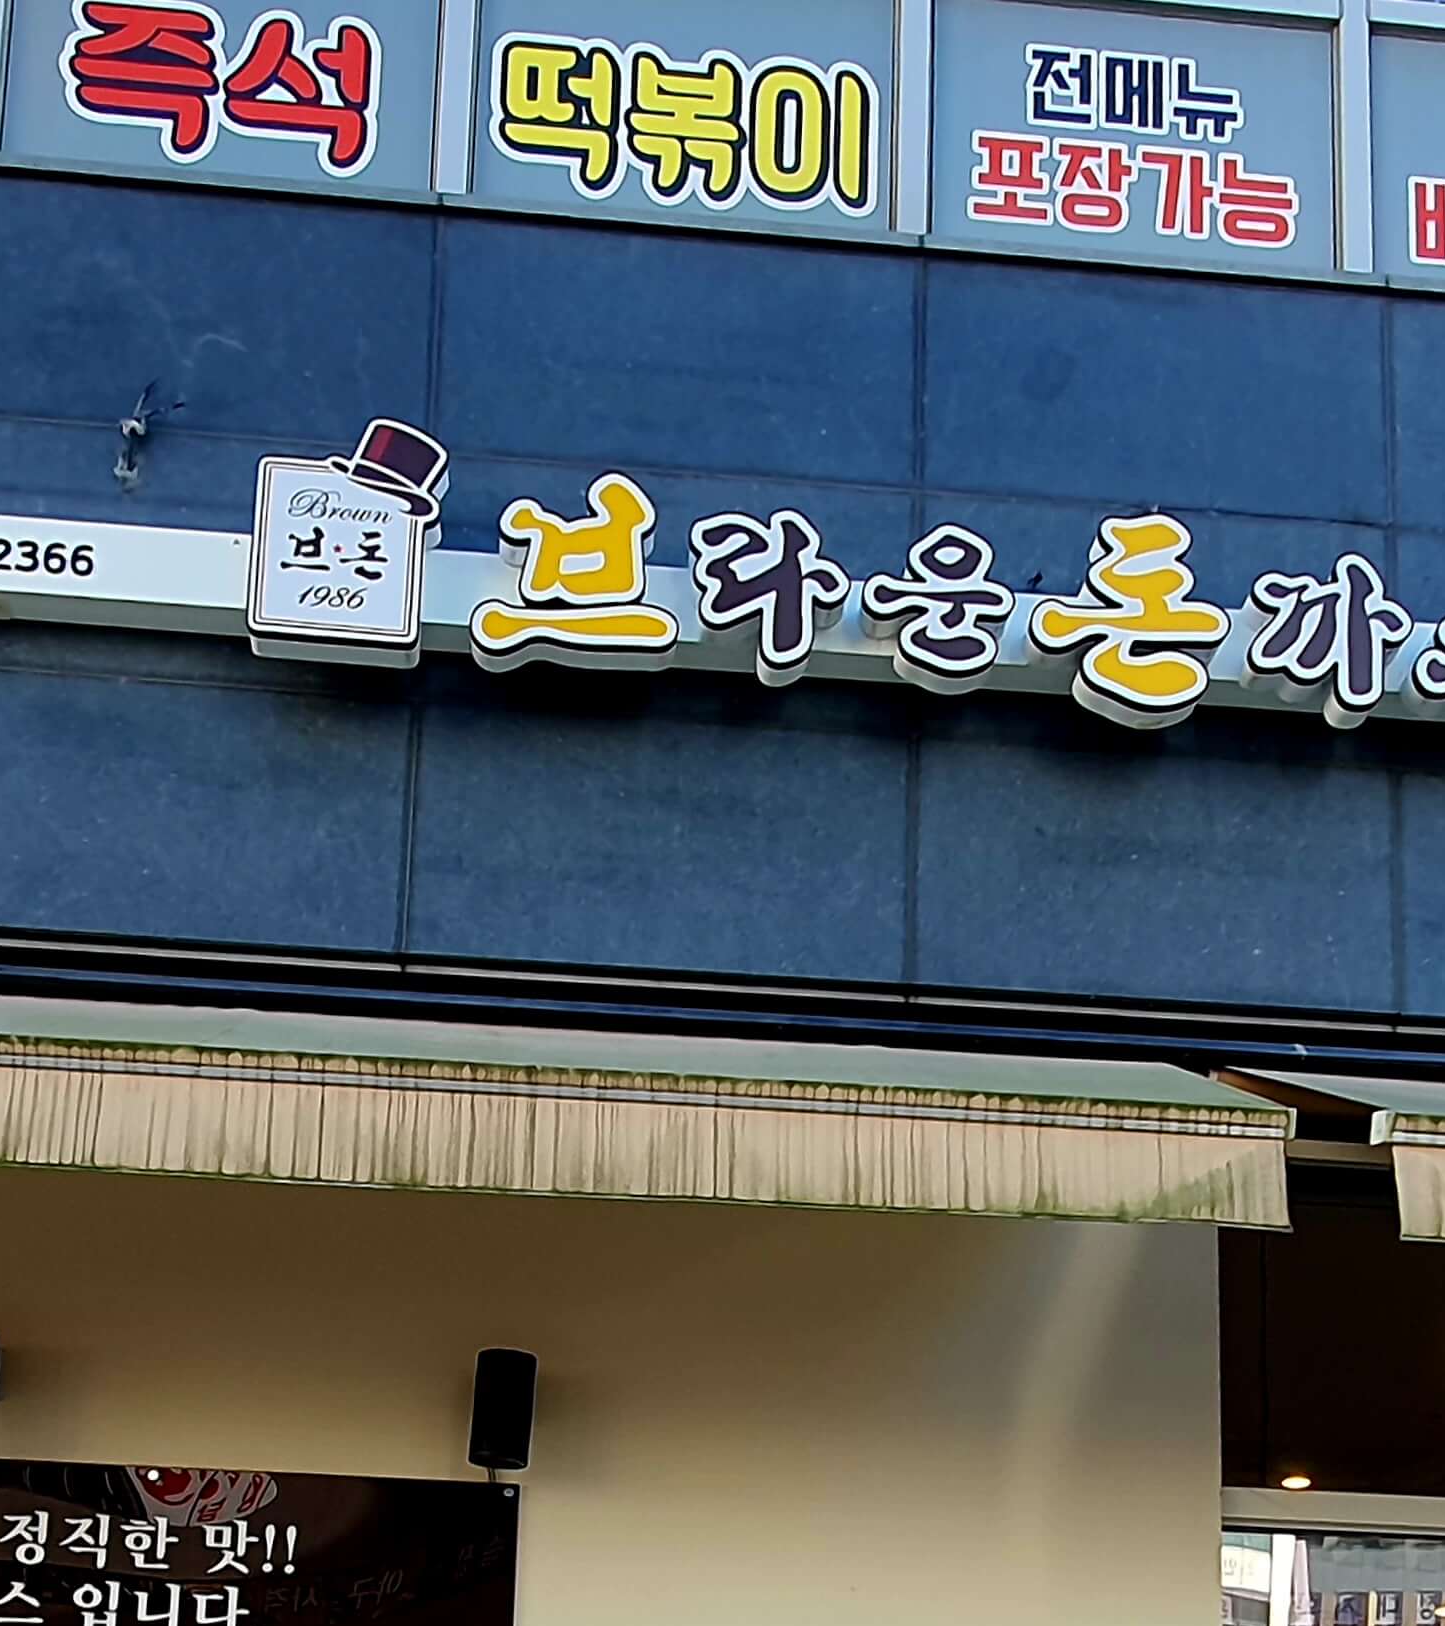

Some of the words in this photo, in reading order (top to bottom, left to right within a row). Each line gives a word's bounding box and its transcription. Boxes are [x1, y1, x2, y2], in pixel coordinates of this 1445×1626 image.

[72, 0, 374, 166] 즉석
[500, 45, 872, 208] 떡볶이
[1026, 45, 1244, 140] 전메뉴
[971, 132, 1296, 242] 포장가능
[288, 488, 394, 524] Brown
[298, 584, 367, 610] 1986
[203, 1519, 298, 1575] 맛!!
